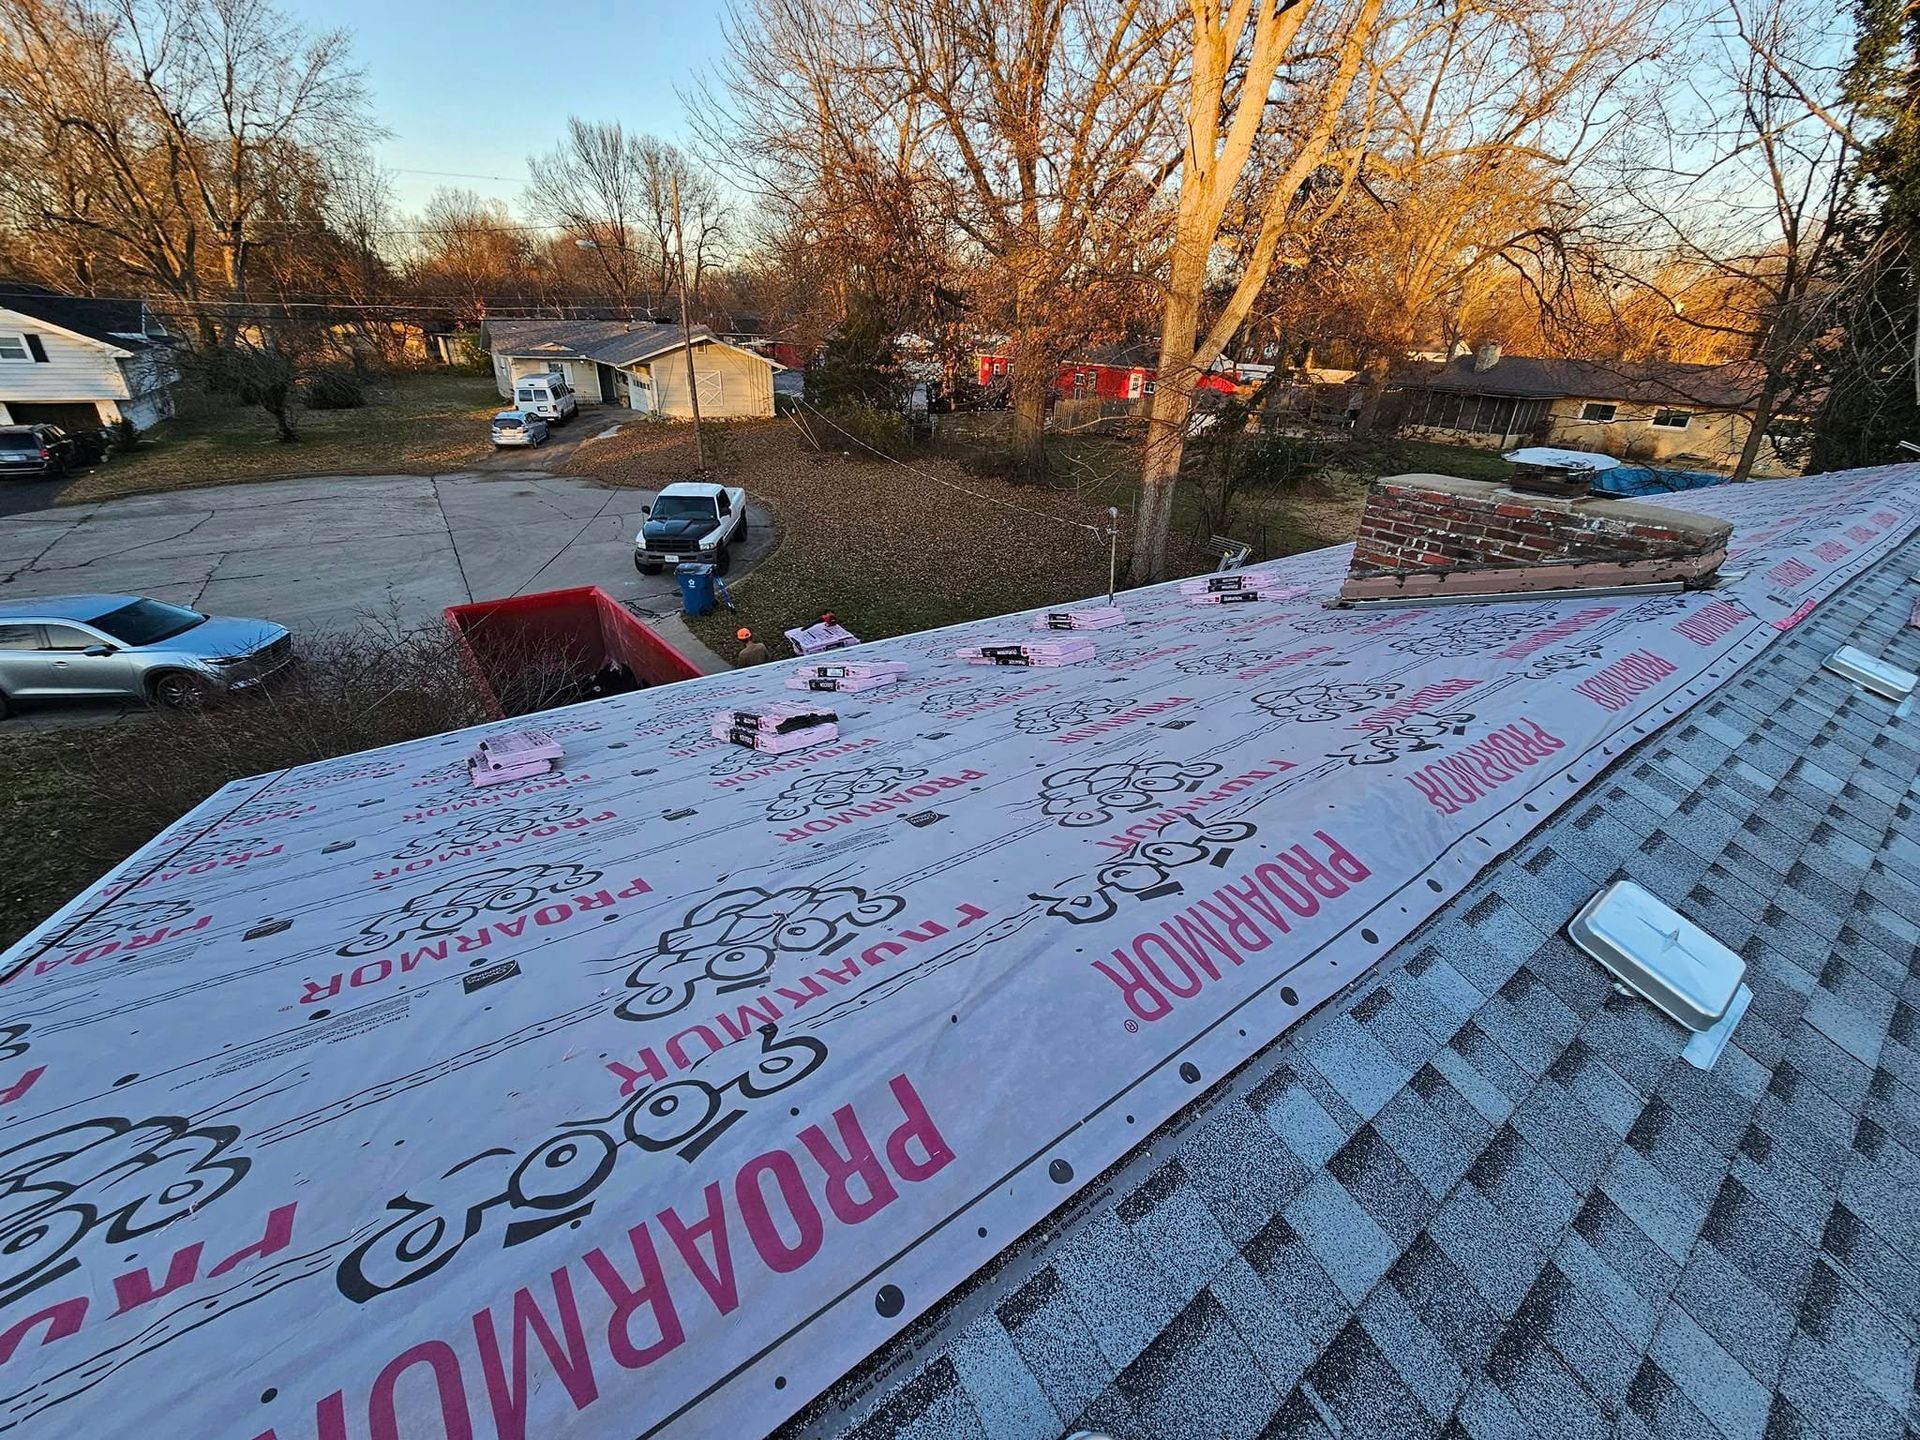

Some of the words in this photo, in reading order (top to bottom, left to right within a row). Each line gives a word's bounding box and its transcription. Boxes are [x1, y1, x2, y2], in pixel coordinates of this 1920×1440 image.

[774, 769, 989, 845] PROARMOR
[371, 810, 618, 881] PROARMOR
[299, 876, 655, 1005] PROARMOR
[1061, 1206, 1091, 1231] Corning
[1089, 1187, 1114, 1209] Owens
[838, 1382, 875, 1412] Owens
[873, 1349, 914, 1384] Corning
